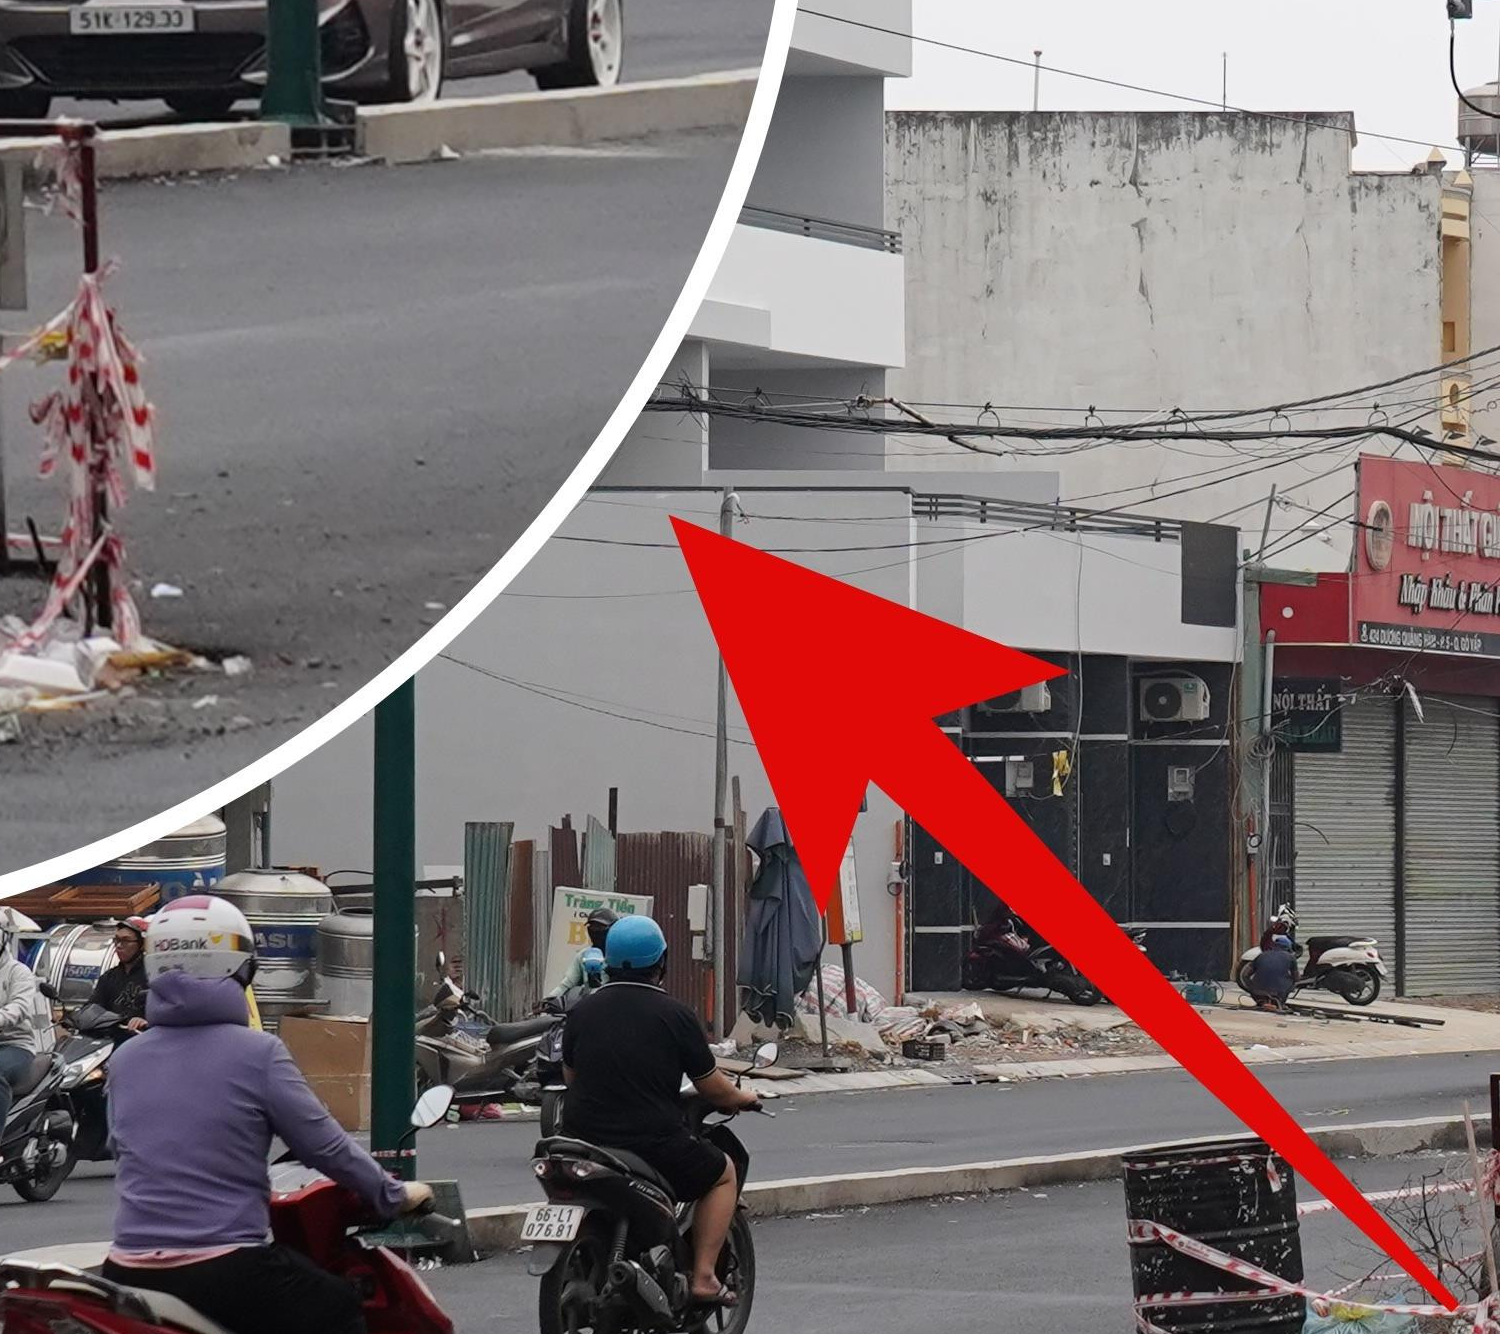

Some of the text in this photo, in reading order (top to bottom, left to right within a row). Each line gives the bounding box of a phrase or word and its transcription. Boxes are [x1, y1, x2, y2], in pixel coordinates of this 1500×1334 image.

[1400, 573, 1428, 612] Nhập
[1430, 571, 1457, 611] Khẩu
[1457, 584, 1468, 609] &
[155, 938, 208, 952] HDBank
[535, 1208, 573, 1222] 66-L1
[525, 1223, 573, 1238] 076.81
